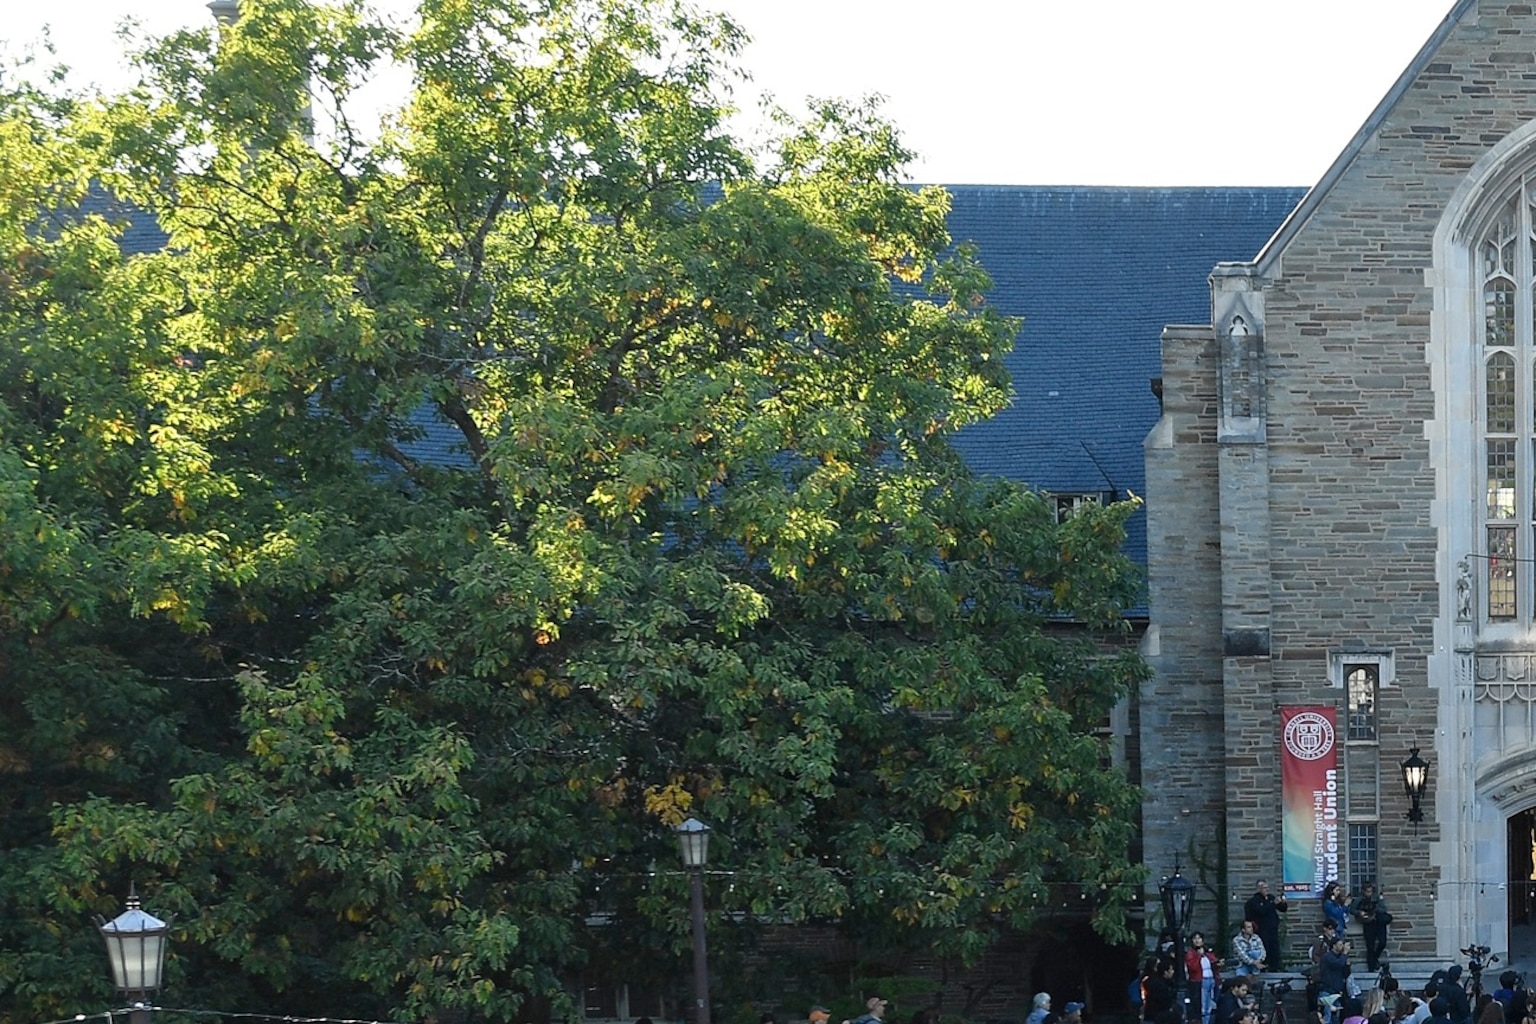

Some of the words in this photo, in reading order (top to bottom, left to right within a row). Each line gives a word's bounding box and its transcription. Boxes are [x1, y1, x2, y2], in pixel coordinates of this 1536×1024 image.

[1313, 790, 1323, 810] Hall
[1322, 769, 1337, 820] Union
[1314, 812, 1326, 854] Straight
[1314, 856, 1324, 892] Willard
[1324, 823, 1338, 887] tudent
